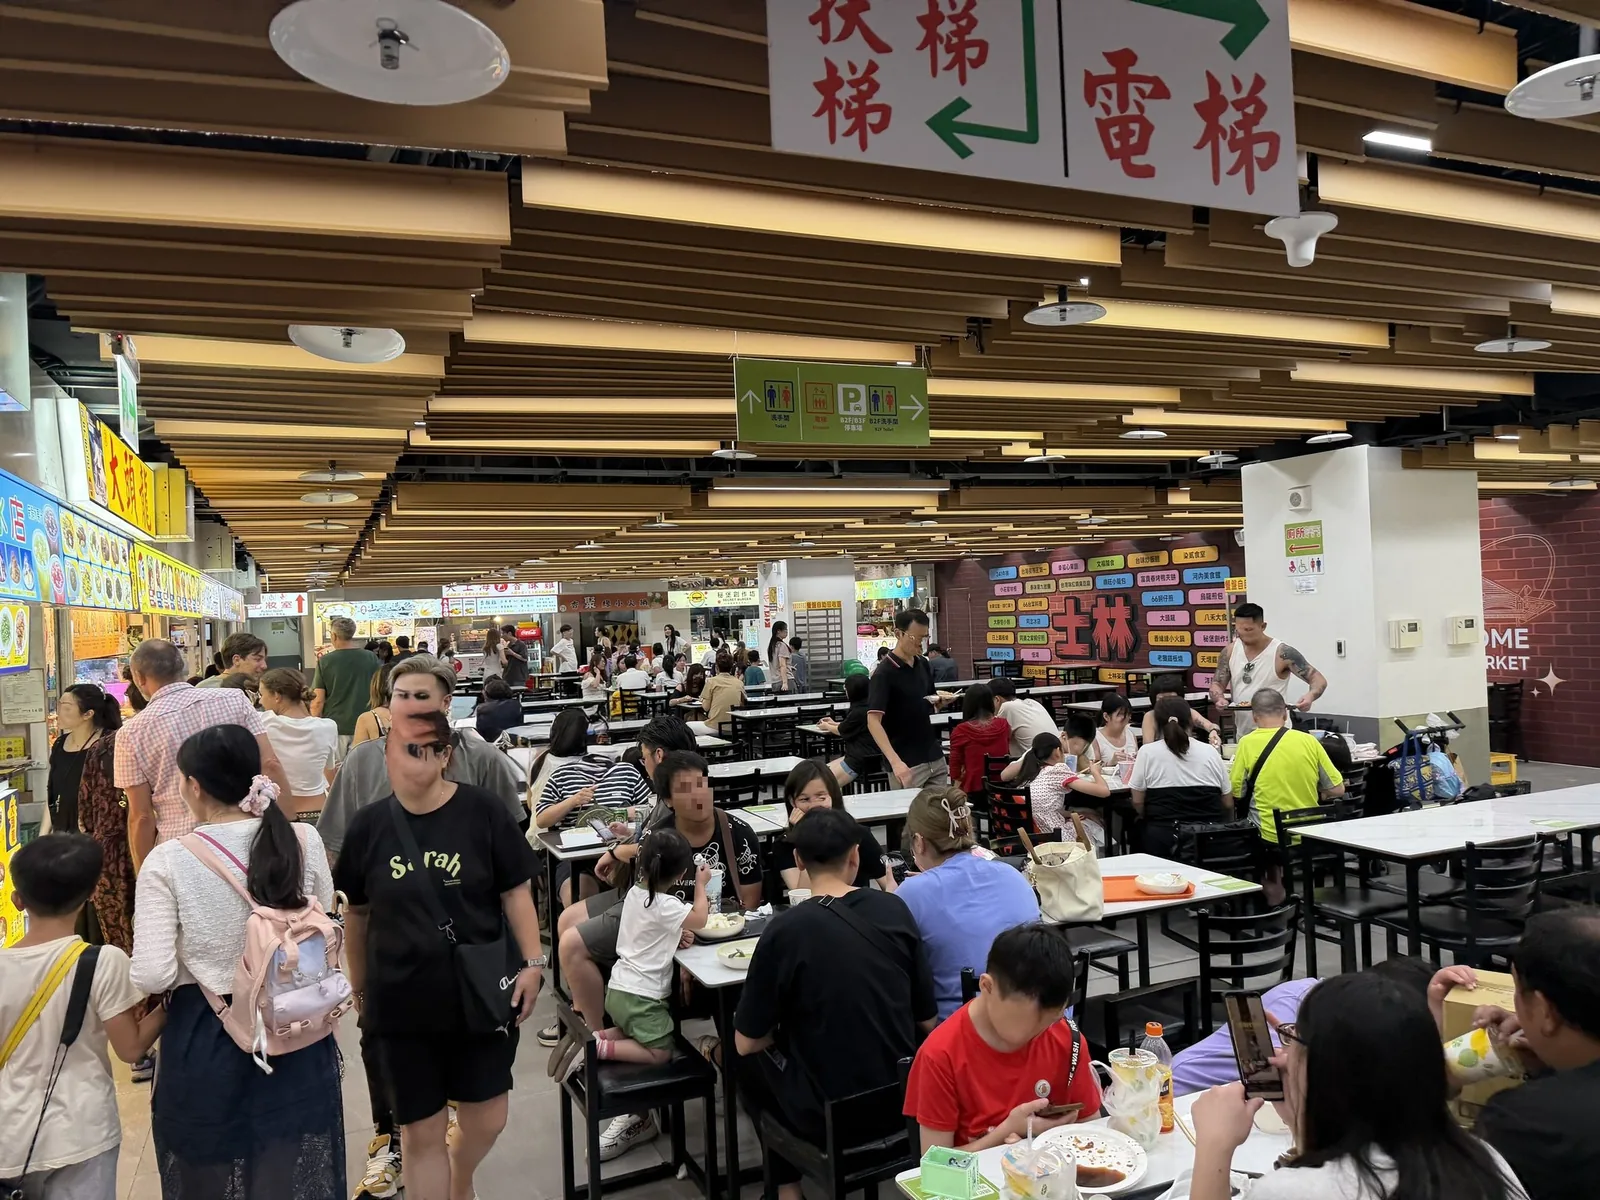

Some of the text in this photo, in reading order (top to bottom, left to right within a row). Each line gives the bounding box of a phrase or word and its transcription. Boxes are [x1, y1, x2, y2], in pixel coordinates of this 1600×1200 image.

[1083, 47, 1281, 195] 電梯
[771, 414, 790, 422] 洗手間
[1052, 597, 1134, 659] 士林
[1071, 1042, 1080, 1066] WASH
